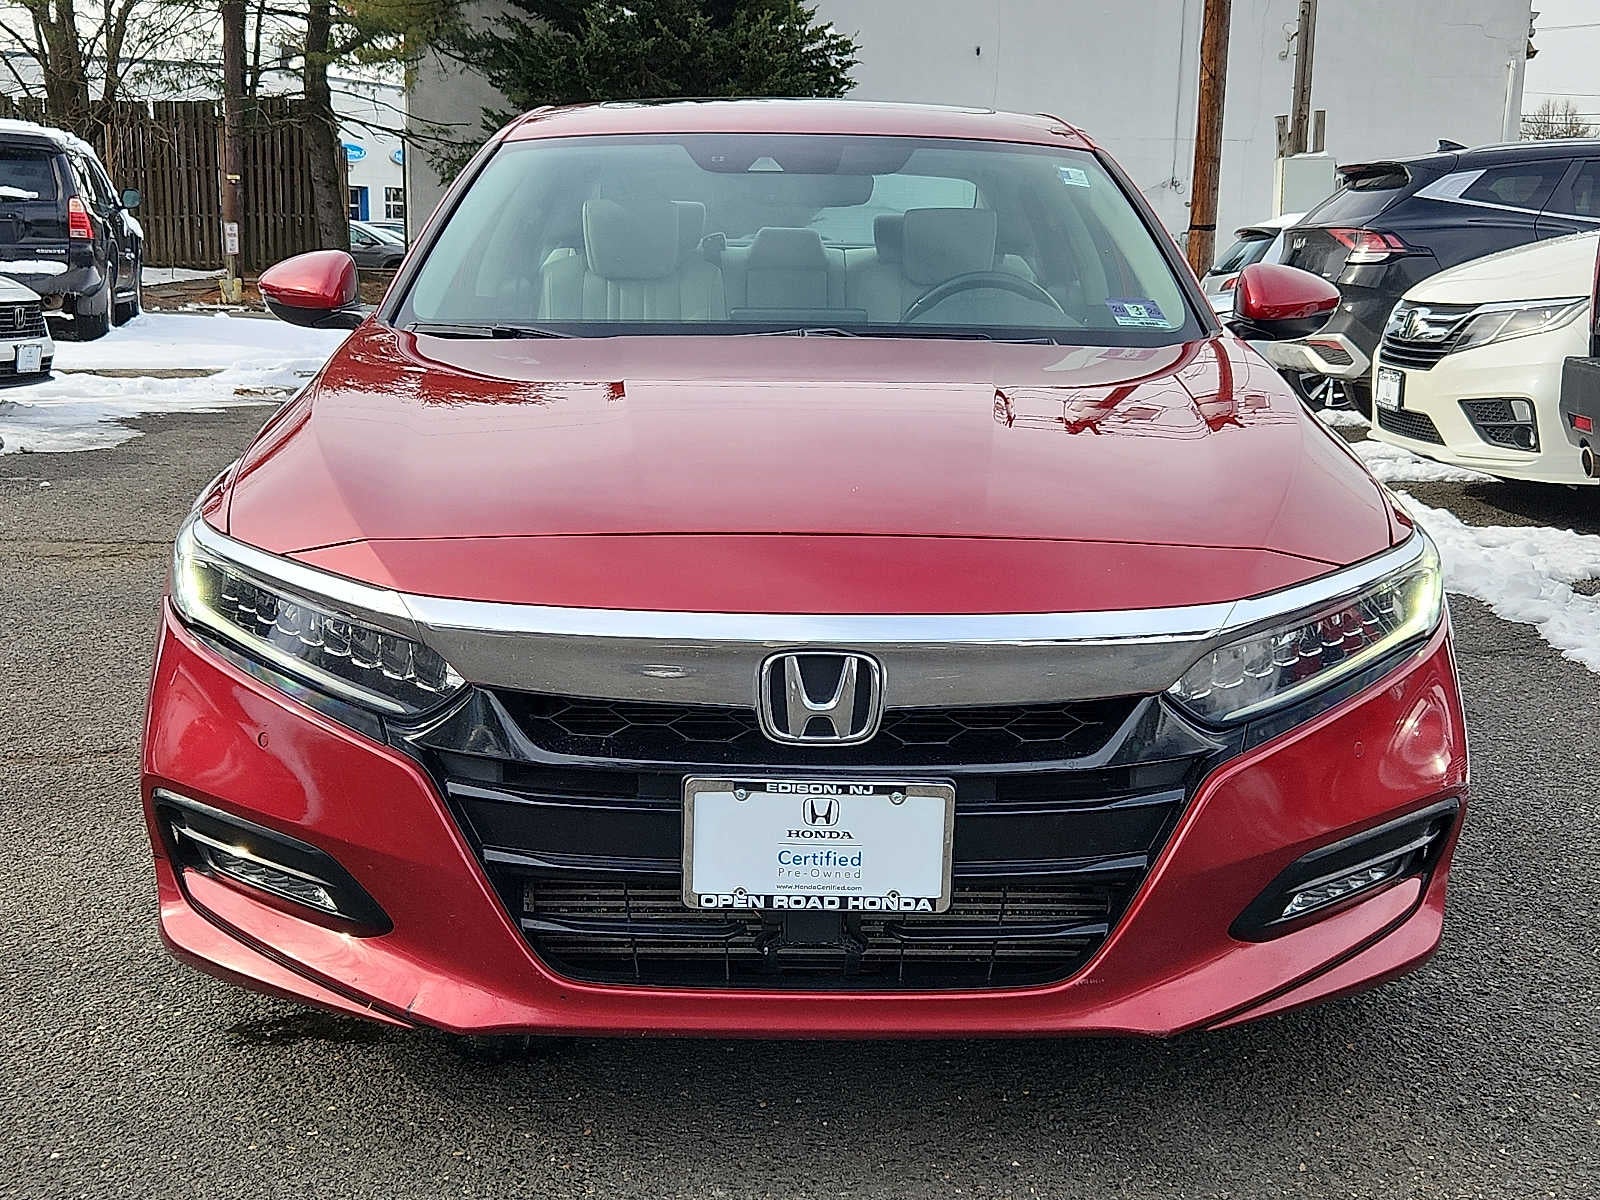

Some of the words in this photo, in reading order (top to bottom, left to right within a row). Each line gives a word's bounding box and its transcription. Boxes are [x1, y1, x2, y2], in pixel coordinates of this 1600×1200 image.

[766, 783, 843, 795] EDISON,
[849, 784, 874, 795] NJ
[786, 829, 855, 840] HONDA
[777, 850, 862, 867] Certified
[777, 867, 862, 879] Pre-Owned
[776, 883, 863, 891] www.HondaCertified.com
[700, 894, 765, 909] OPEN
[773, 895, 840, 910] ROAD
[848, 896, 933, 911] HONDA
